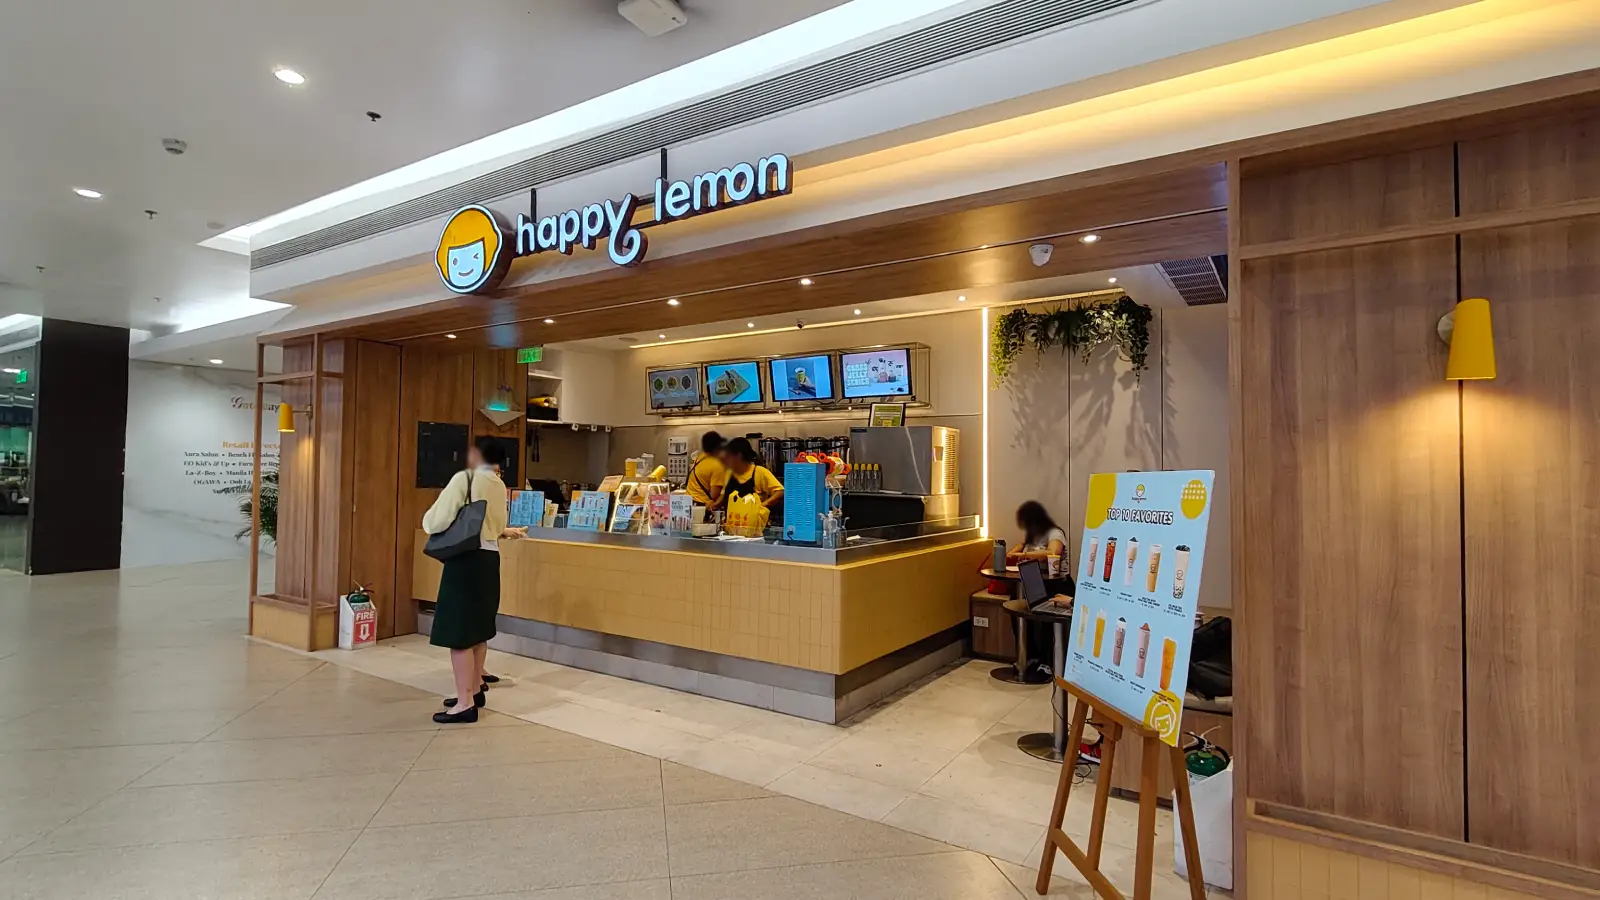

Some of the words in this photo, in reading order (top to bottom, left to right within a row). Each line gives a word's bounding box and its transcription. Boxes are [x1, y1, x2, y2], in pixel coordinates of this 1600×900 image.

[516, 193, 645, 266] happy
[654, 152, 791, 222] lemon
[231, 396, 280, 413] Gatway
[1107, 507, 1121, 521] TOP
[1121, 508, 1131, 522] 10
[1130, 509, 1174, 525] FAVORITES
[356, 611, 375, 621] FIRE
